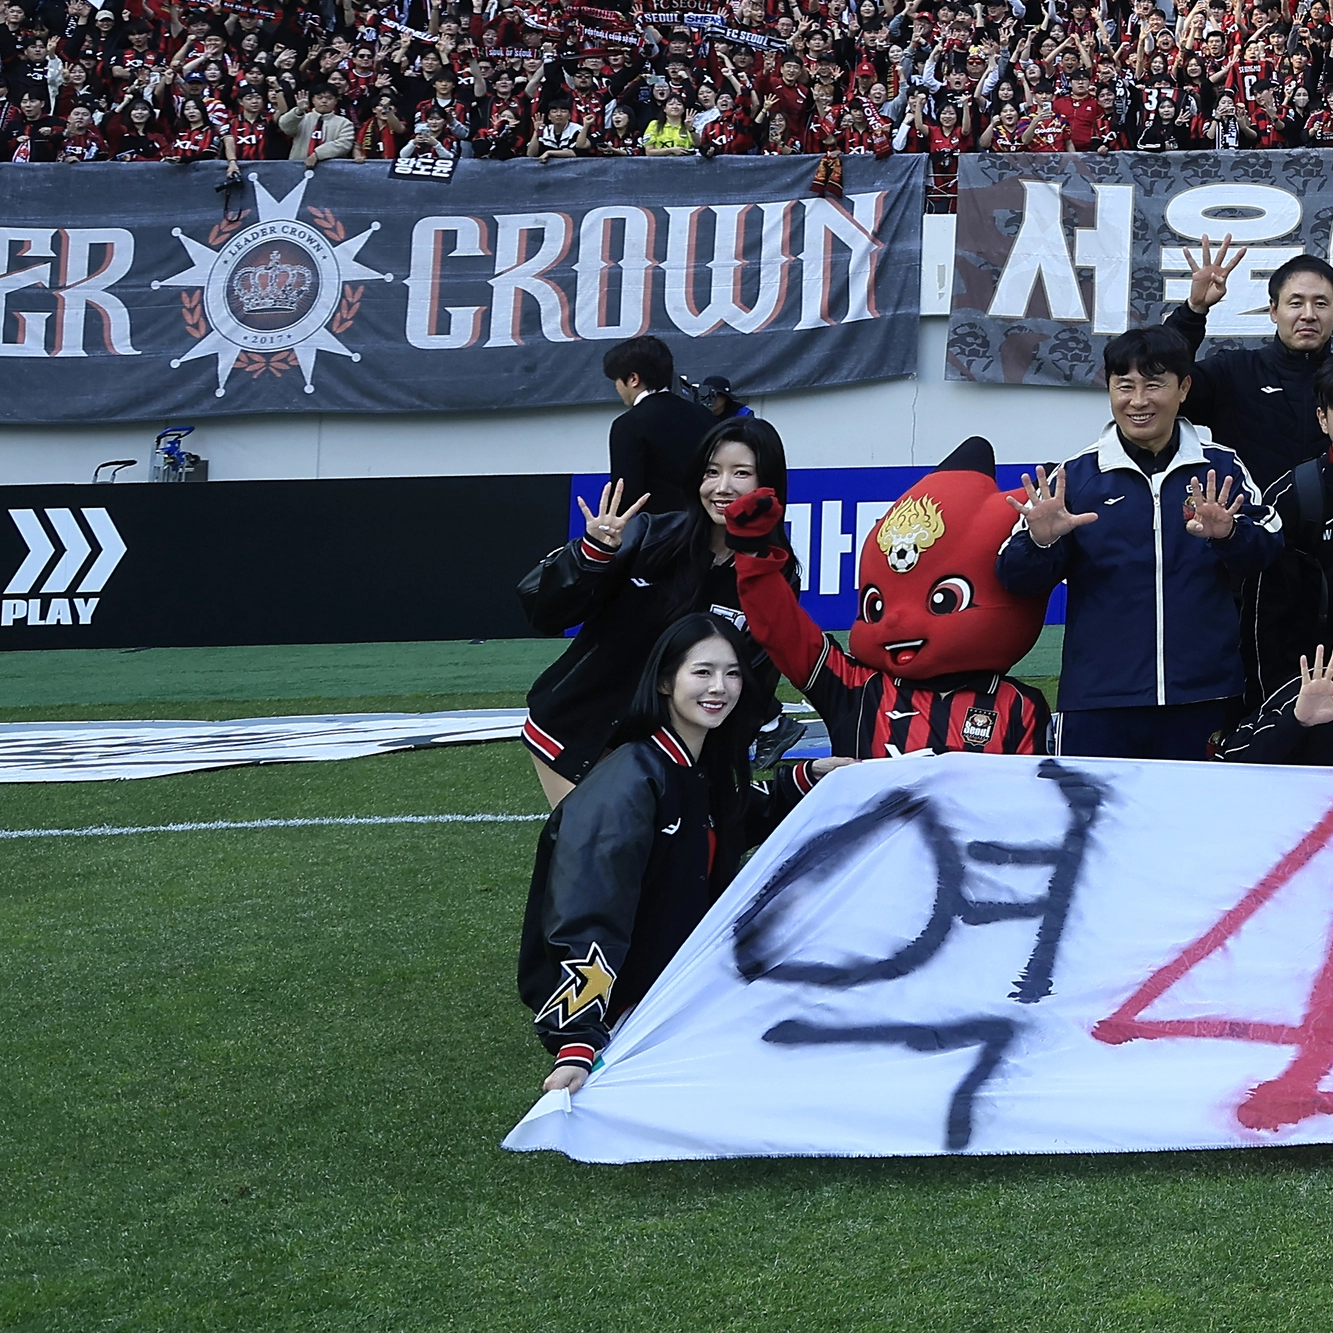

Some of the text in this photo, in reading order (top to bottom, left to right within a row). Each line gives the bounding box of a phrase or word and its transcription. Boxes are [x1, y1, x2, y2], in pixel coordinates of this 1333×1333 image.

[228, 225, 323, 257] LEADER CROWN
[403, 191, 888, 350] CROWN
[251, 335, 284, 346] 2017
[1, 598, 100, 626] PLAY
